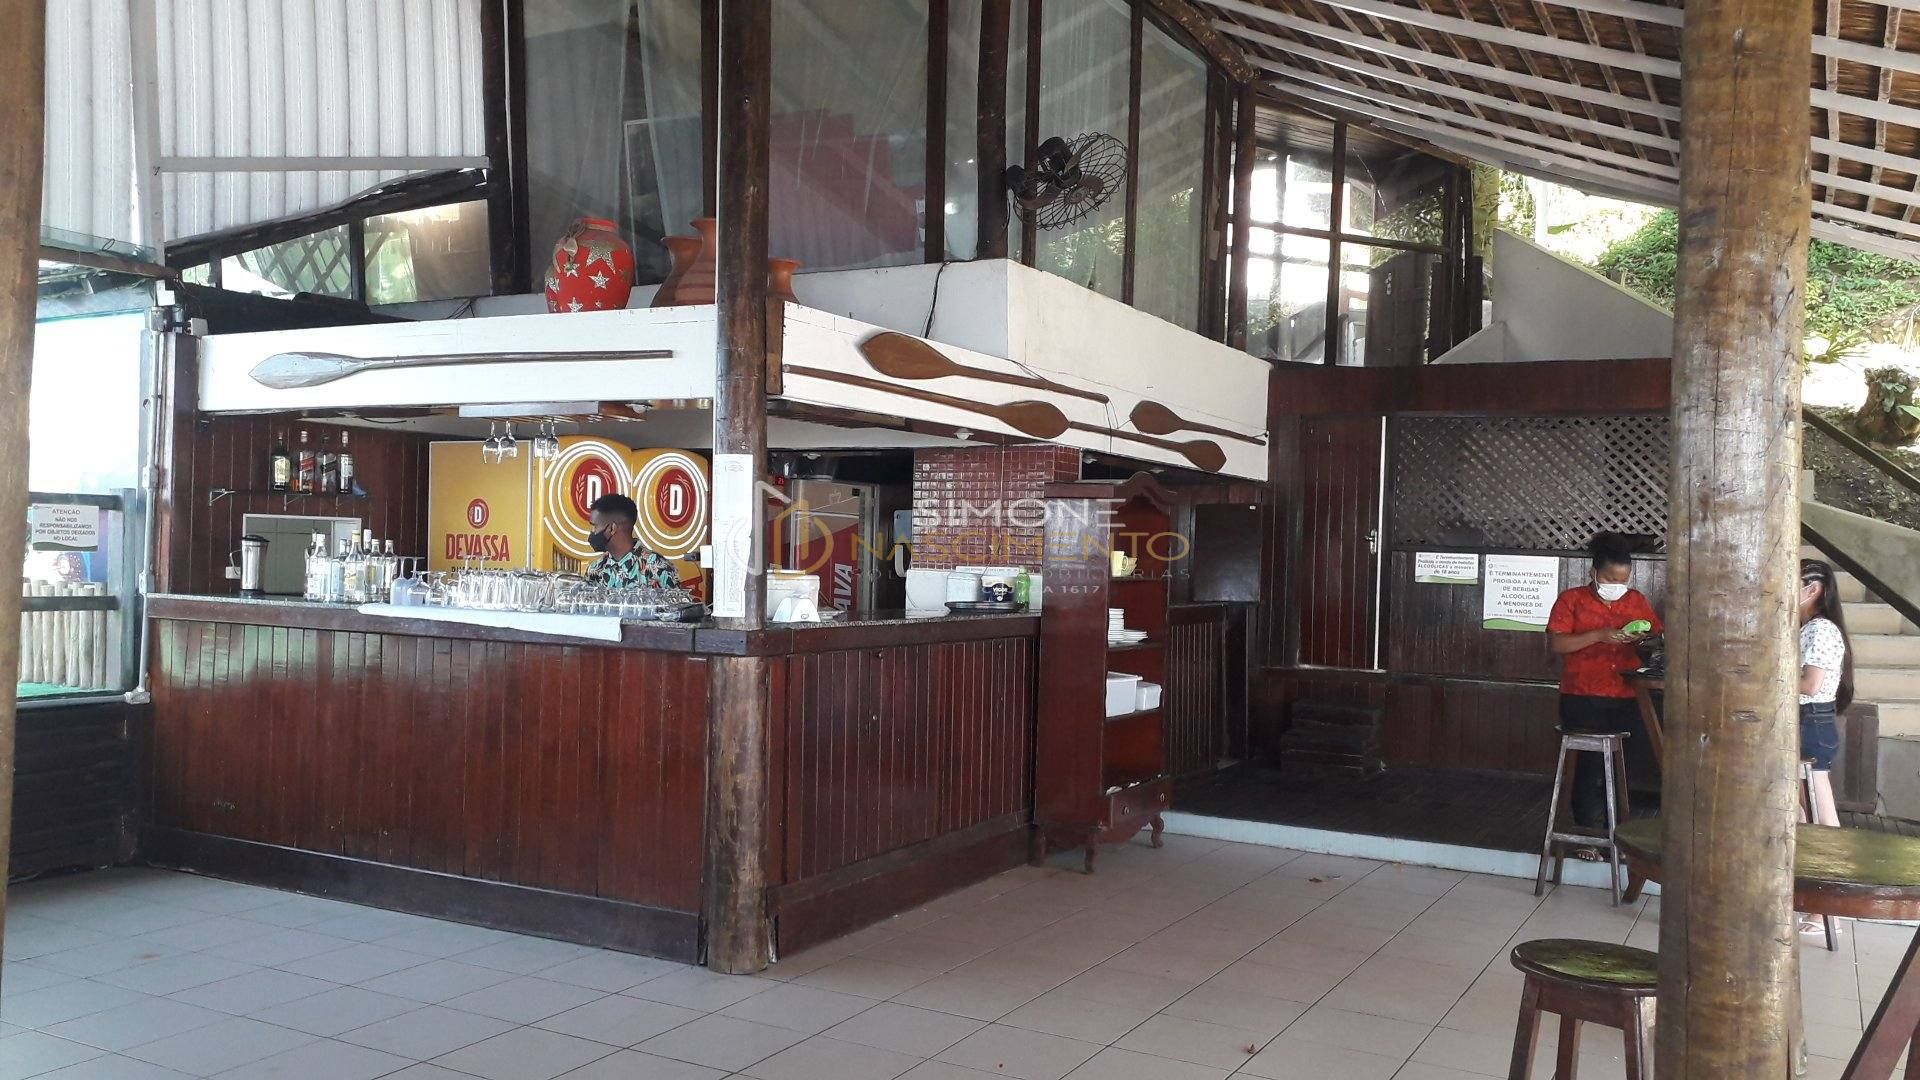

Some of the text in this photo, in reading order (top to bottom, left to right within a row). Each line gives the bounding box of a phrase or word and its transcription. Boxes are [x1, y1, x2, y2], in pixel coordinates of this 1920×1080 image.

[474, 506, 482, 523] D
[669, 484, 683, 516] D
[445, 533, 511, 562] DEVASSA
